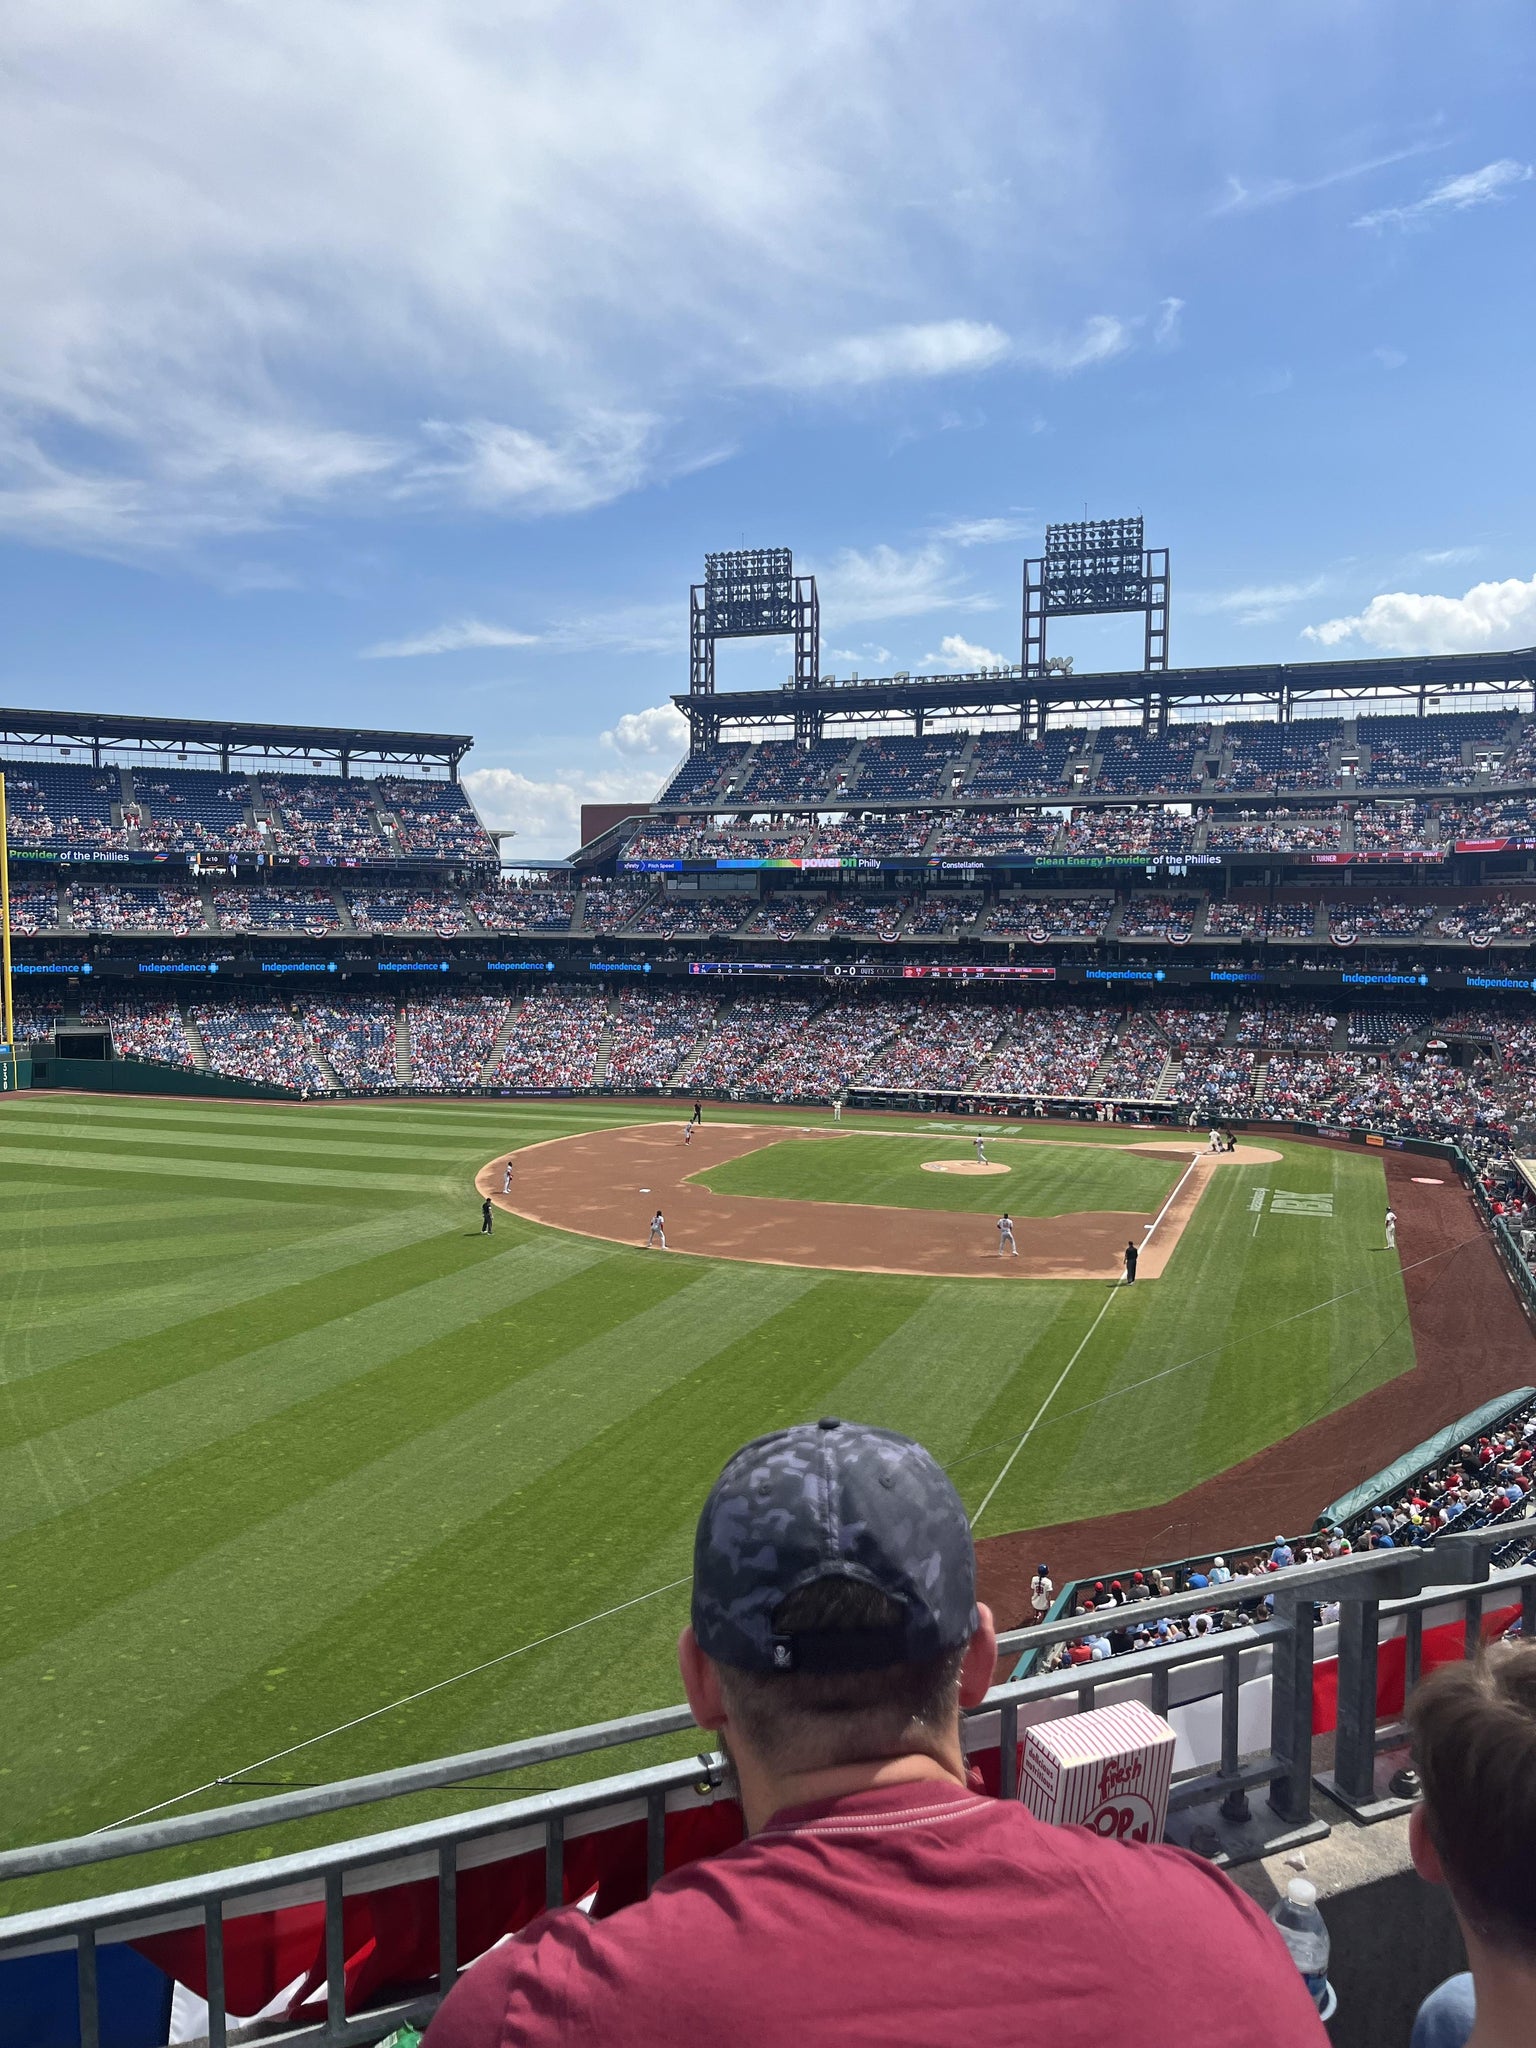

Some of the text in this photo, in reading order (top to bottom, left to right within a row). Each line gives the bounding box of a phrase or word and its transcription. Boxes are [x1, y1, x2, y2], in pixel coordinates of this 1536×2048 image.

[9, 849, 130, 861] Provider of the Phillies
[858, 859, 881, 868] Philly
[1035, 855, 1222, 867] Clean Energy Provider of the Phillies
[10, 964, 80, 974] ndependence
[138, 963, 206, 974] Independence
[262, 962, 326, 973] Independence
[378, 962, 438, 972] Independence
[487, 962, 544, 971] Independence
[590, 962, 642, 972] Independence
[1086, 970, 1153, 980] Independence
[1342, 973, 1416, 984] Independence
[1466, 976, 1529, 988] Independence
[1270, 1189, 1334, 1217] IBX
[1028, 1749, 1054, 1780] delicious
[1025, 1760, 1054, 1792] nutritious
[1098, 1757, 1143, 1800] fresh
